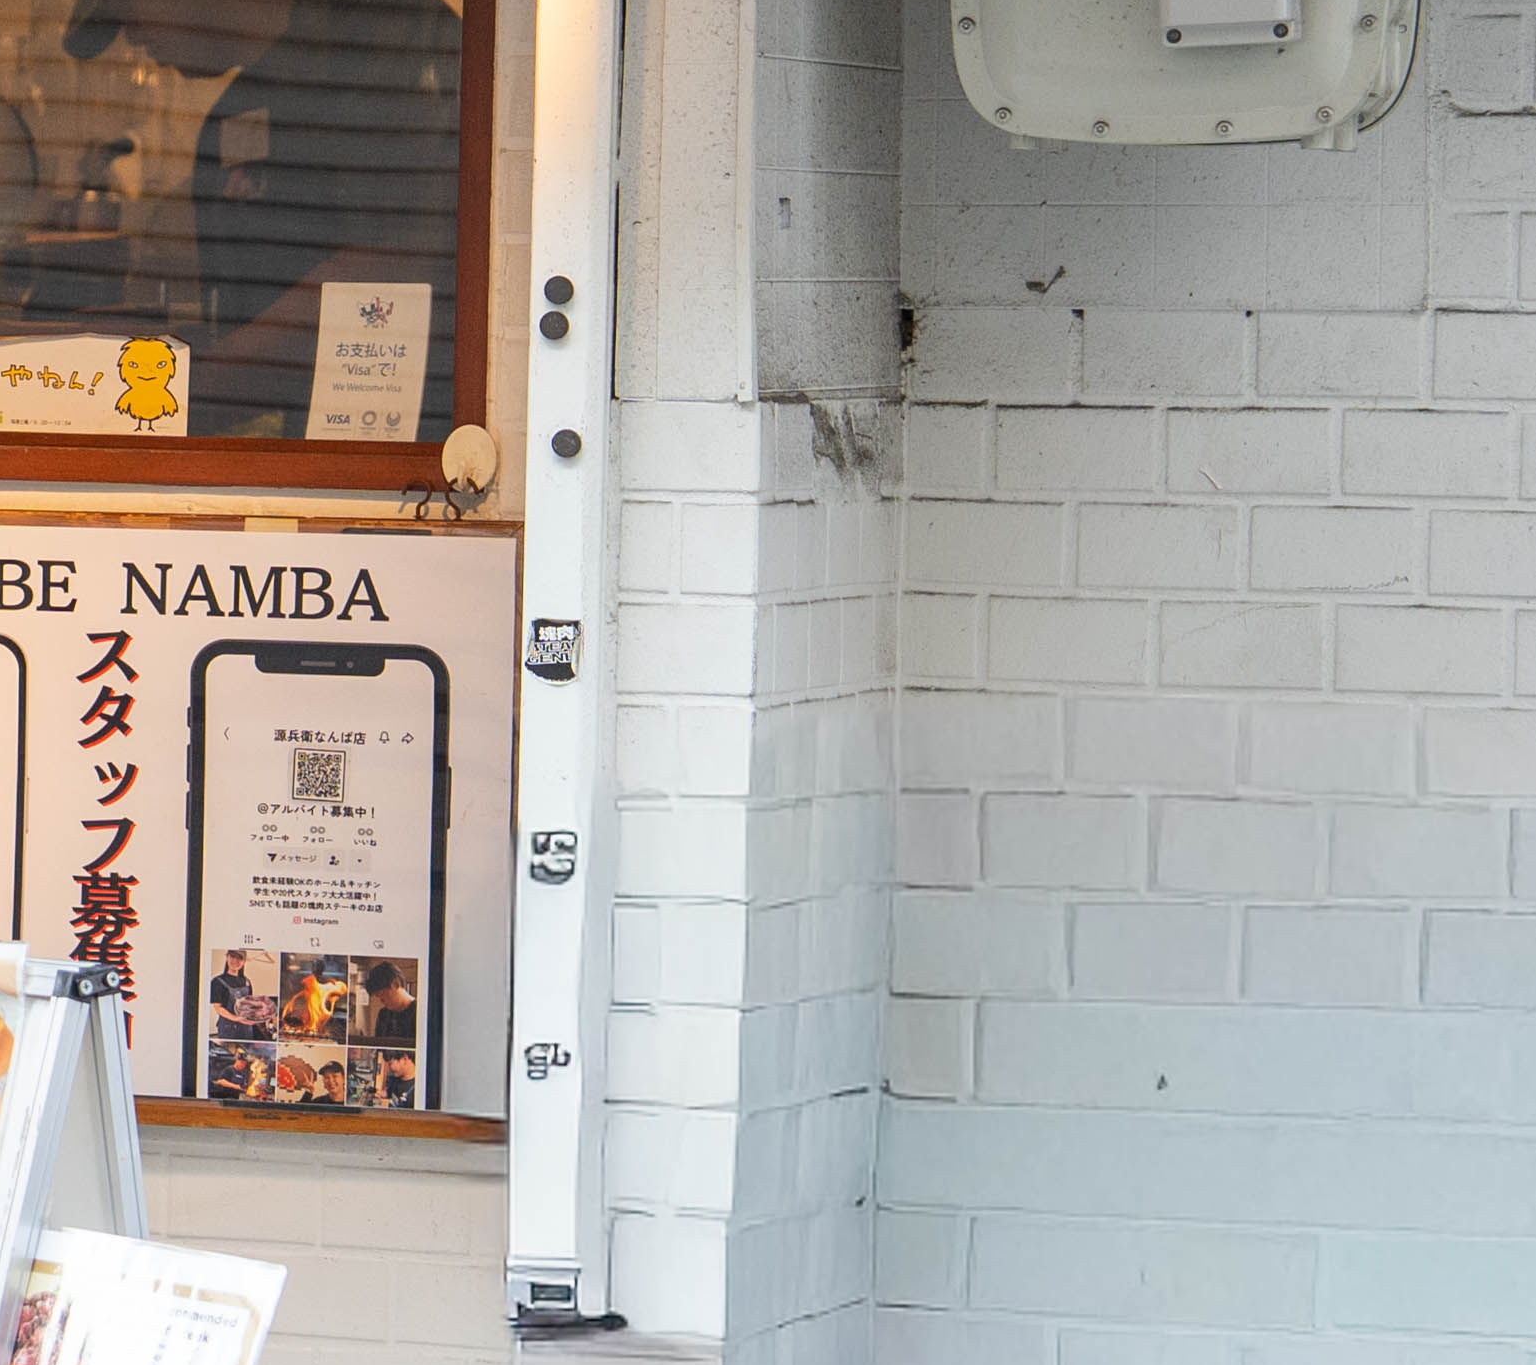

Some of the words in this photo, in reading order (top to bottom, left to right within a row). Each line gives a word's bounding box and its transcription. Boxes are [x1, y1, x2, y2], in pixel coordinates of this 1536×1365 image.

[336, 342, 407, 358] お支払いは
[346, 383, 384, 393] Welcome
[326, 414, 351, 425] VISA
[121, 562, 390, 623] NAMBA
[274, 729, 366, 744] 源兵衛なんば店
[303, 917, 339, 926] Instagram
